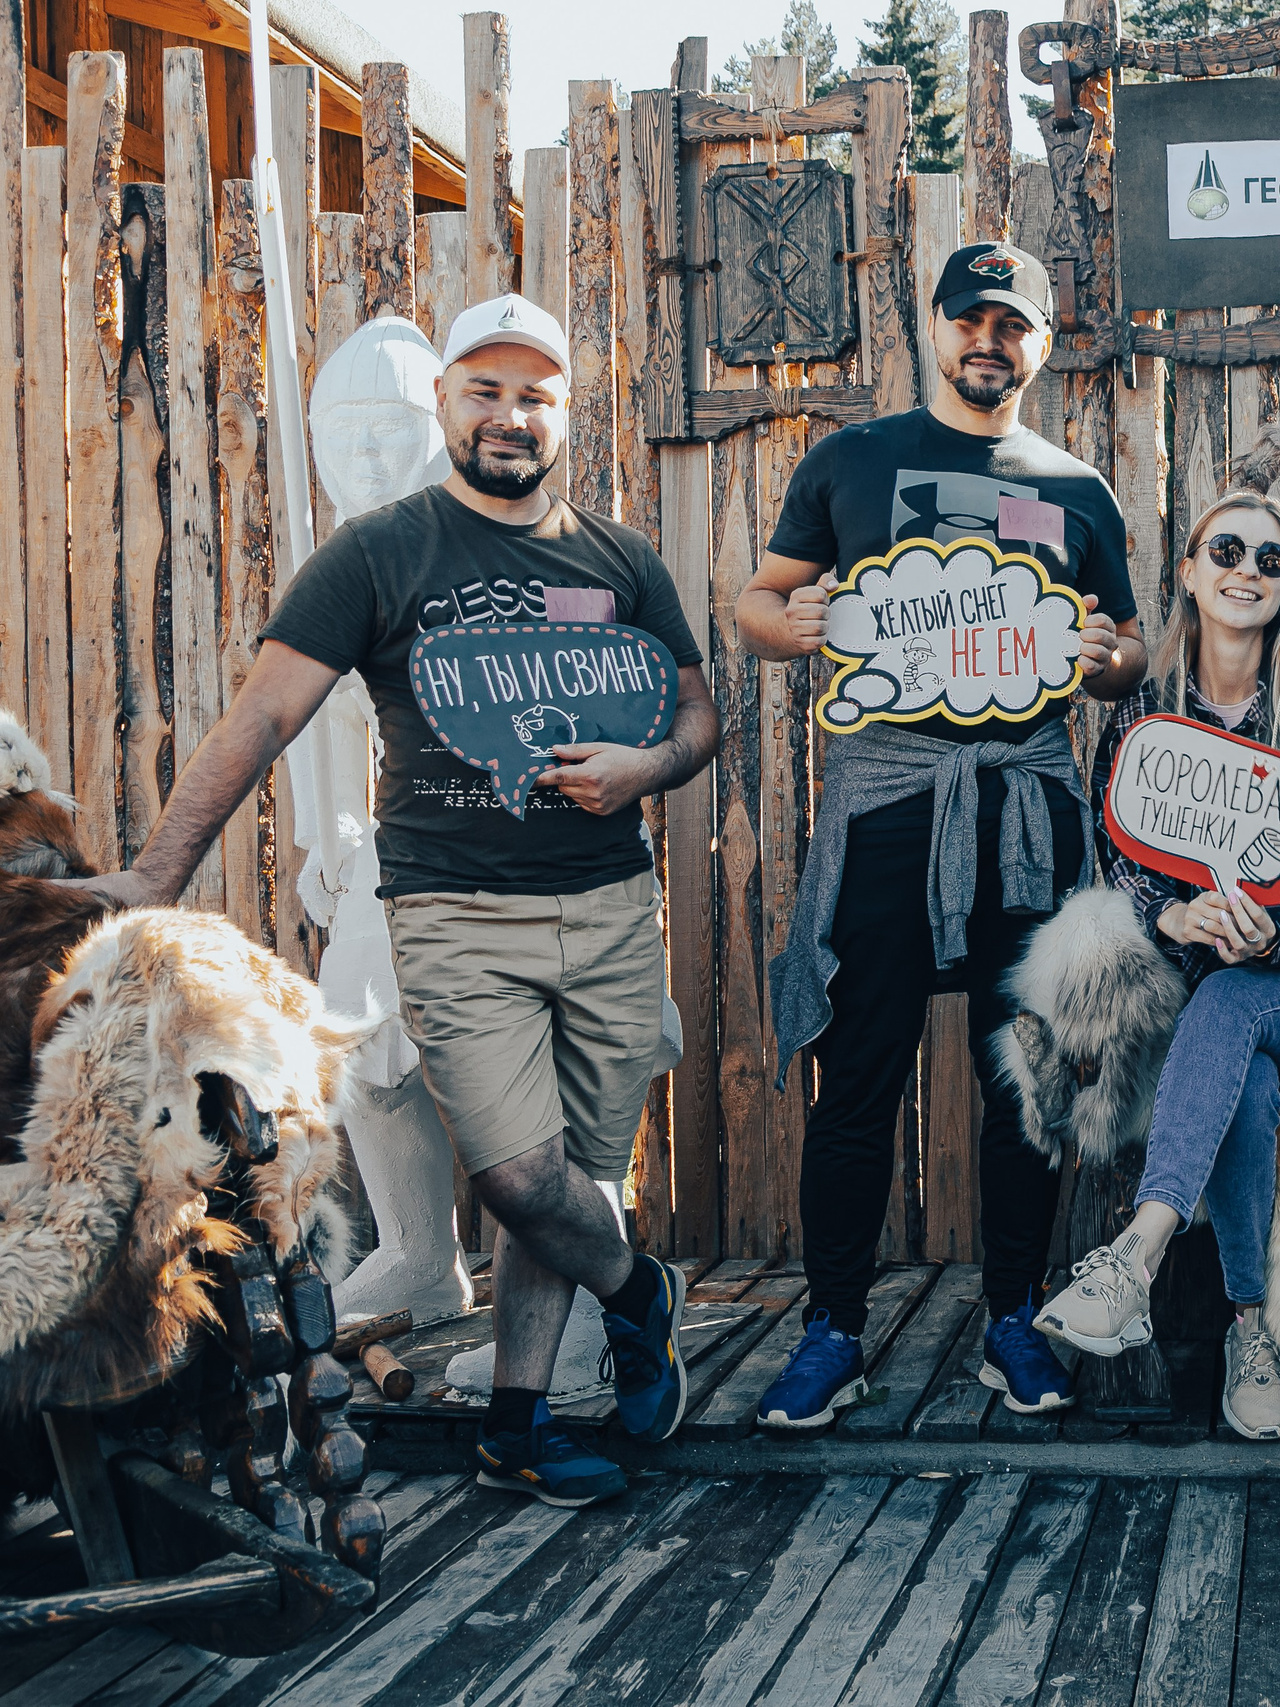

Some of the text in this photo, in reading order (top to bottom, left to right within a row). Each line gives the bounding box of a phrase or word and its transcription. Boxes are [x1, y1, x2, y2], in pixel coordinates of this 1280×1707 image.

[417, 573, 590, 634] CESS
[870, 582, 1008, 641] ЖЁЛТЫЙ СНЕГ
[424, 644, 654, 713] НУ, ТЫ И СВИНН
[952, 626, 1037, 678] НЕ ЕМ
[1140, 796, 1236, 852] ТУШЕНКИ
